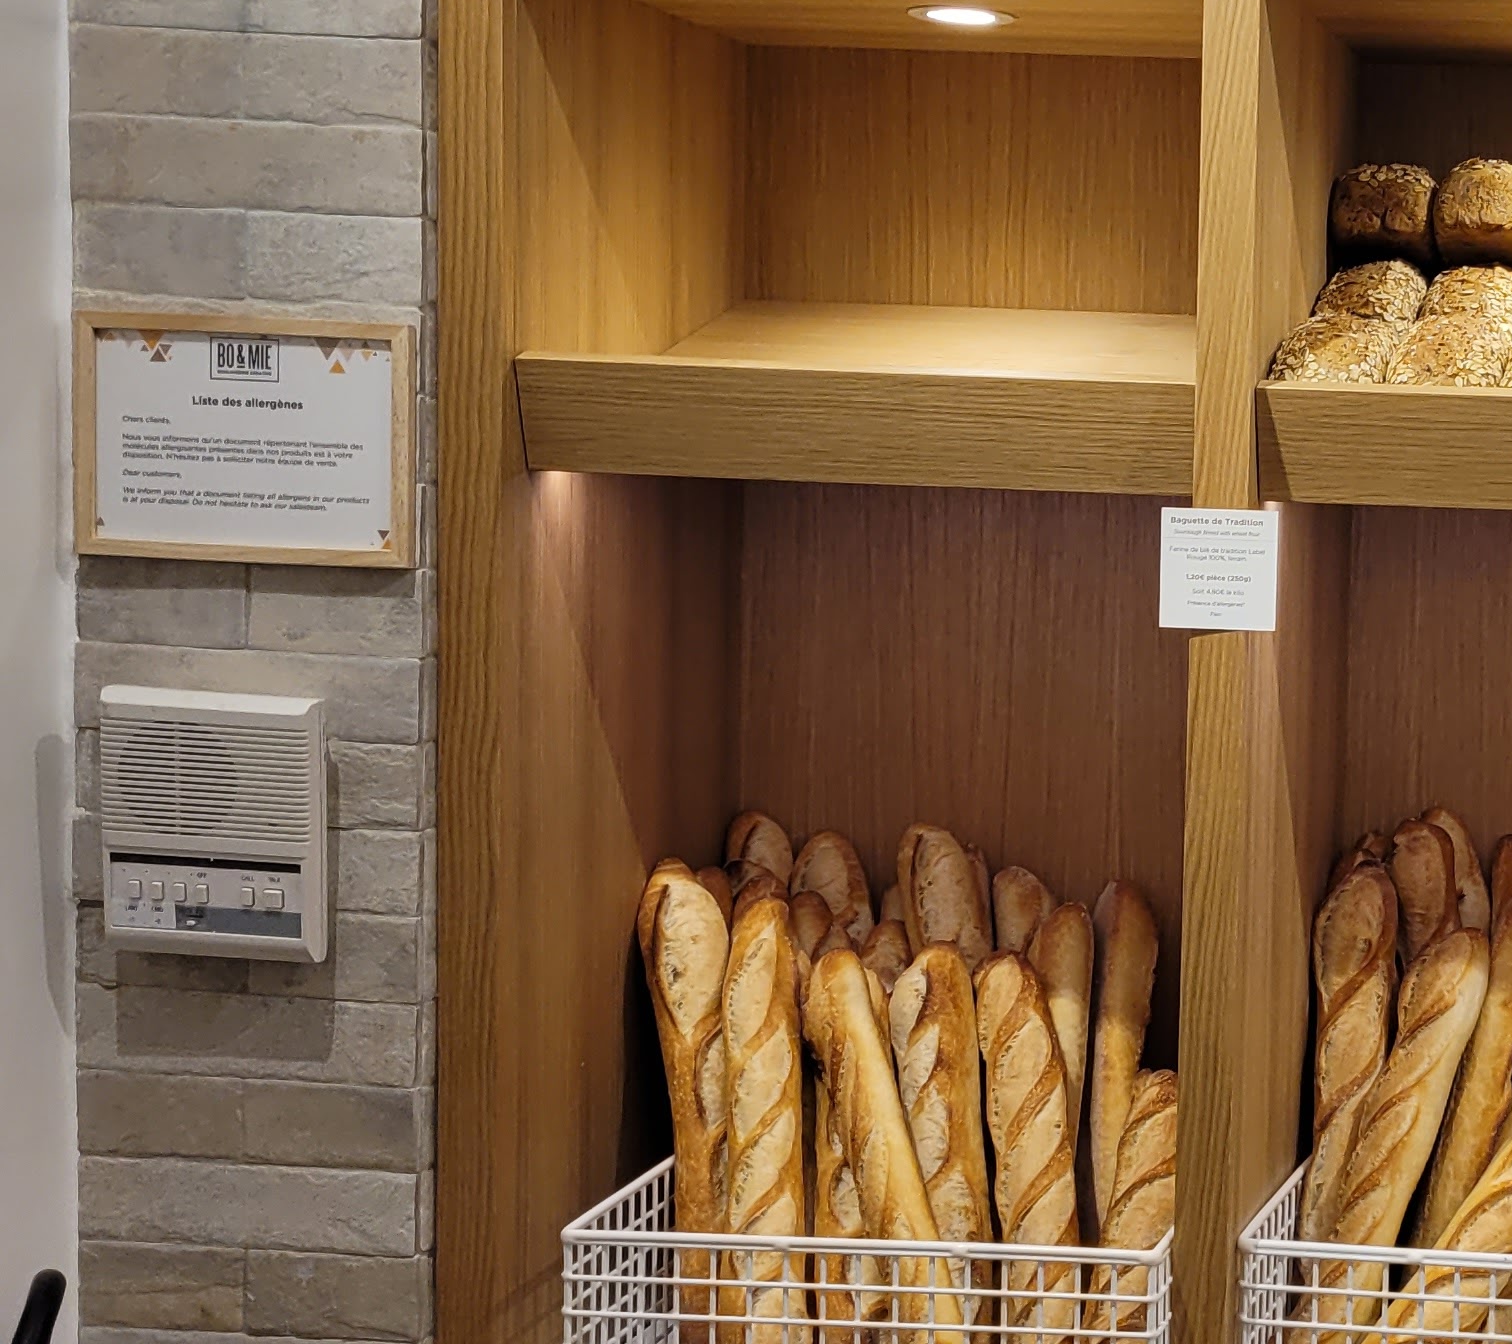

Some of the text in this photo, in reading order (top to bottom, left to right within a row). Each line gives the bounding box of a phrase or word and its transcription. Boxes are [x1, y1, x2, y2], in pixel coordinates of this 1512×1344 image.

[217, 342, 273, 371] BO & MIE
[192, 396, 304, 410] Liste des allergènes
[1170, 516, 1264, 527] Baguette de Tradition
